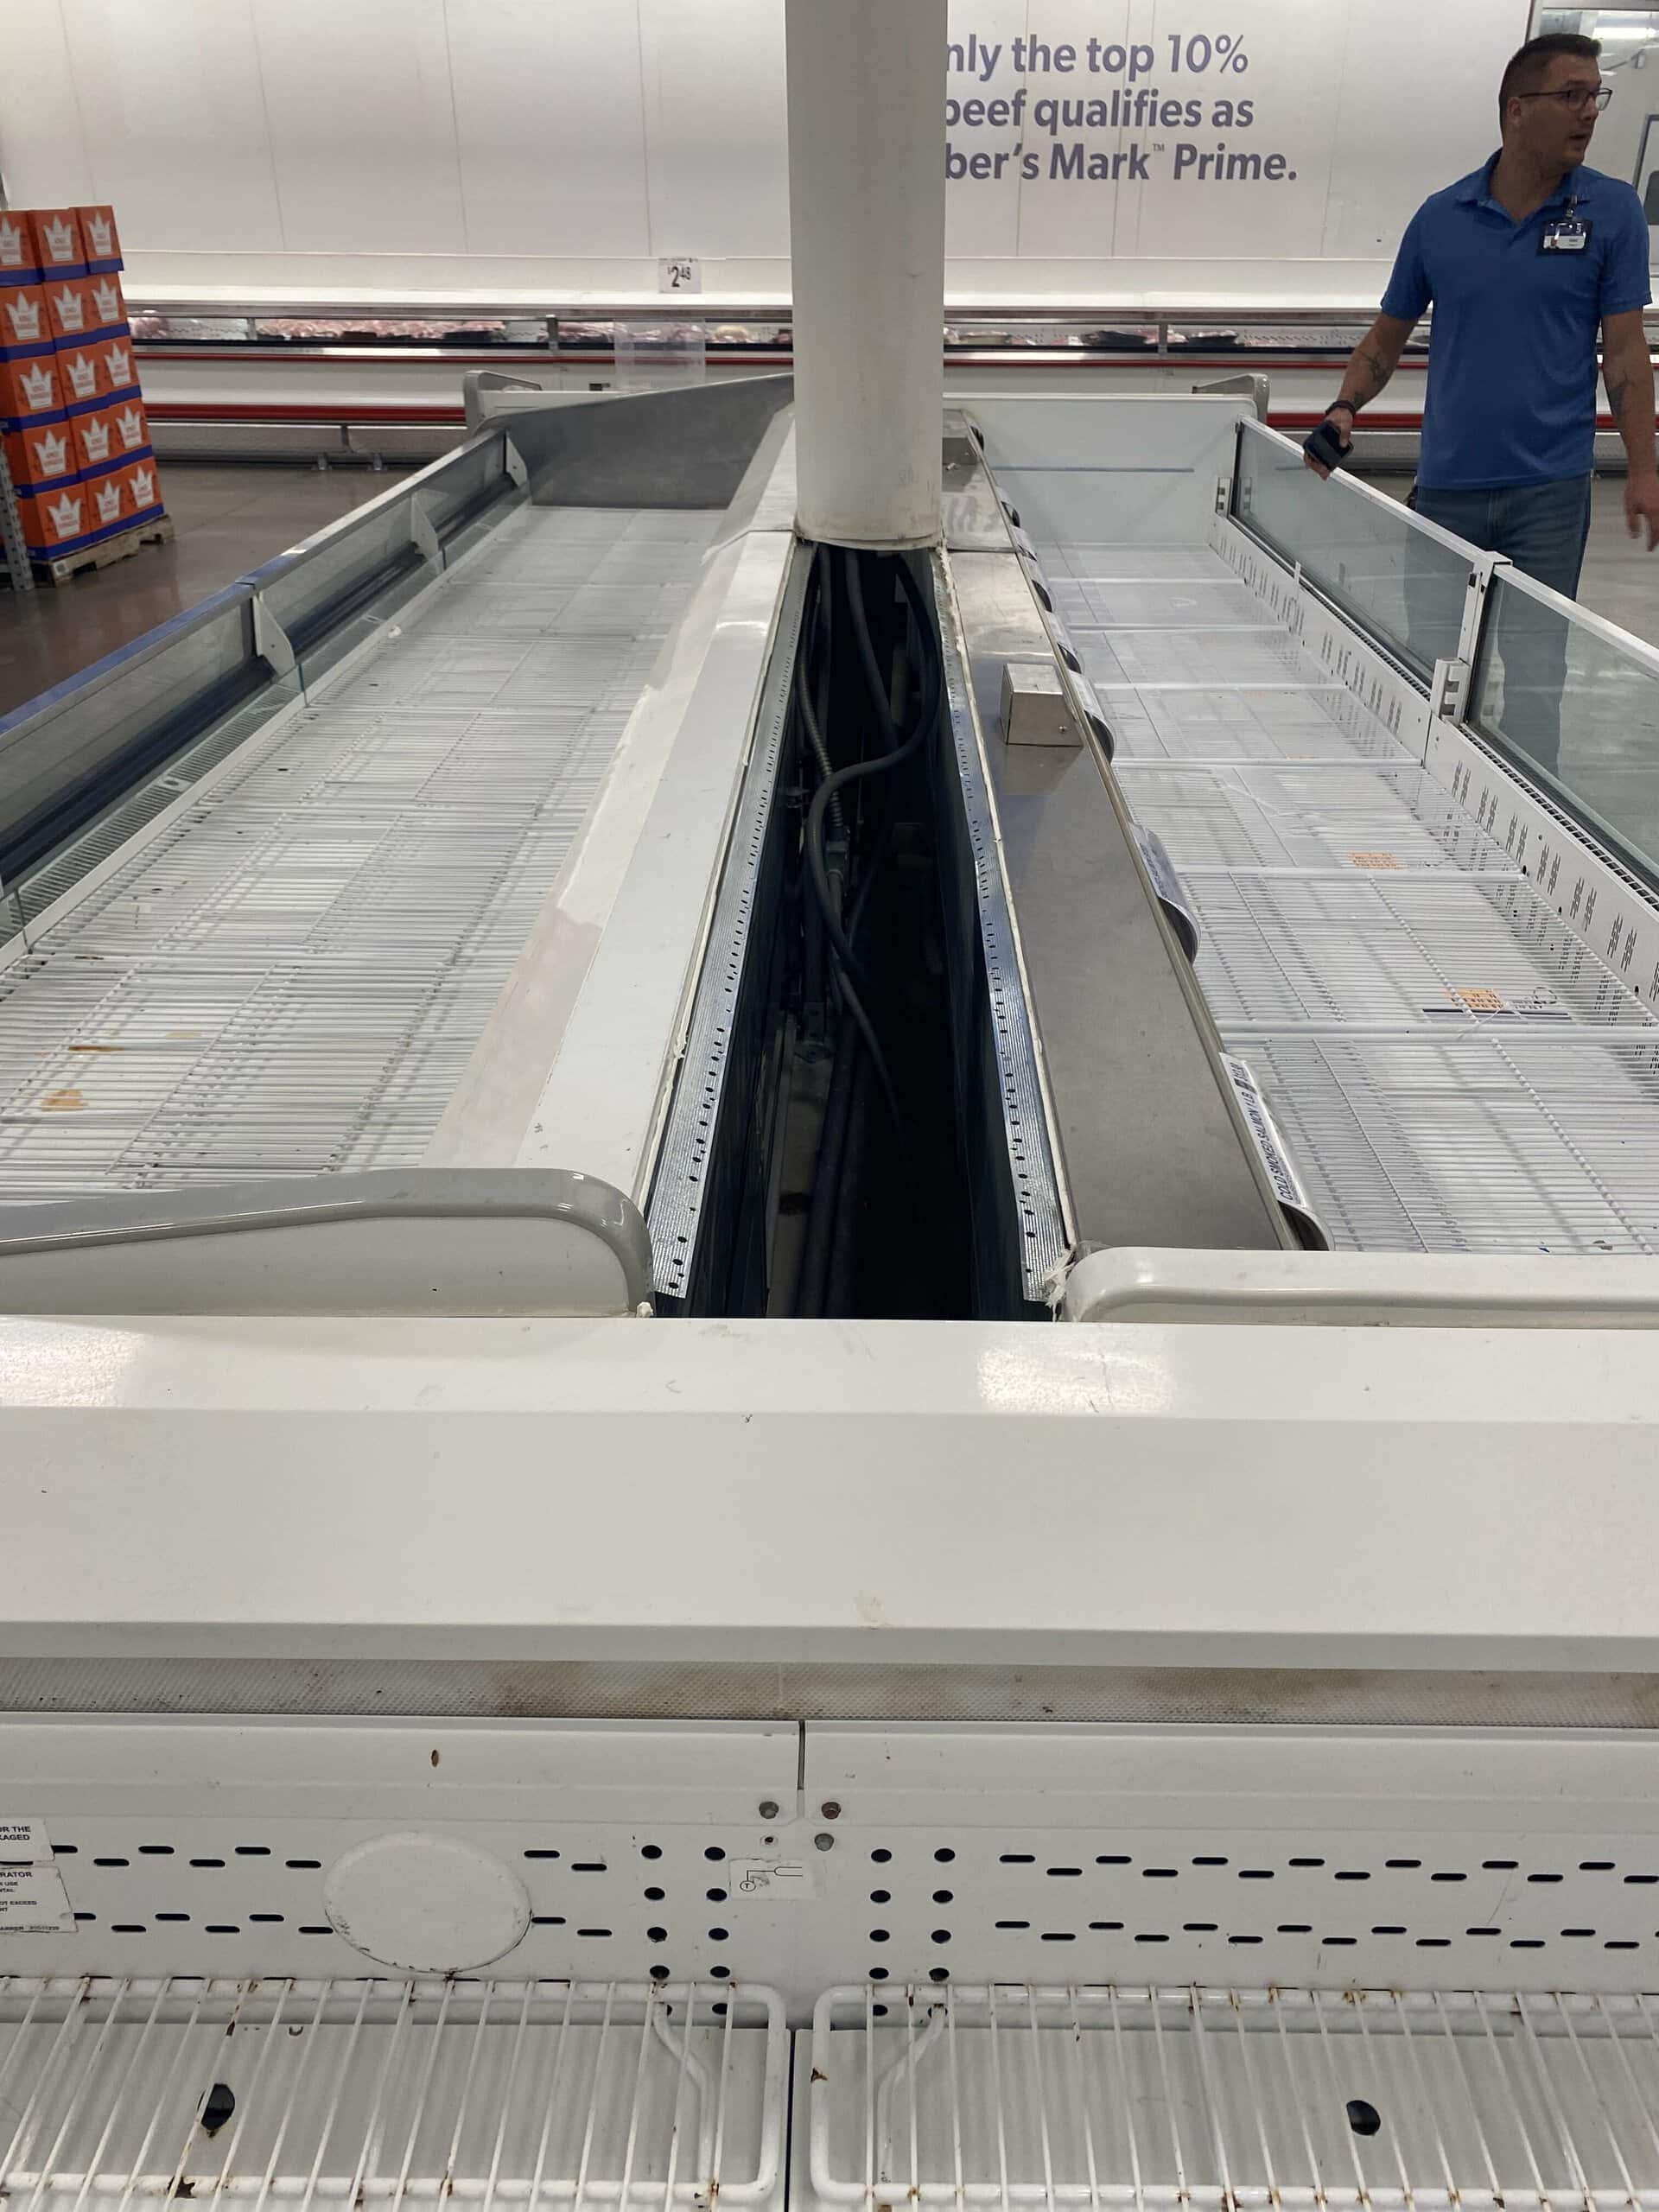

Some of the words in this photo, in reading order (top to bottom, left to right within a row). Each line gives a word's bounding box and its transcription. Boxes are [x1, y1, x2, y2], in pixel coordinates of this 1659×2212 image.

[1011, 34, 1077, 73] the
[1086, 37, 1154, 82] top
[1167, 34, 1249, 73] 10%
[1034, 88, 1202, 136] qualifies
[1211, 99, 1254, 127] as
[1173, 143, 1297, 180] Prime.
[1260, 1140, 1283, 1176] SMOKED
[1273, 1174, 1294, 1201] COLD
